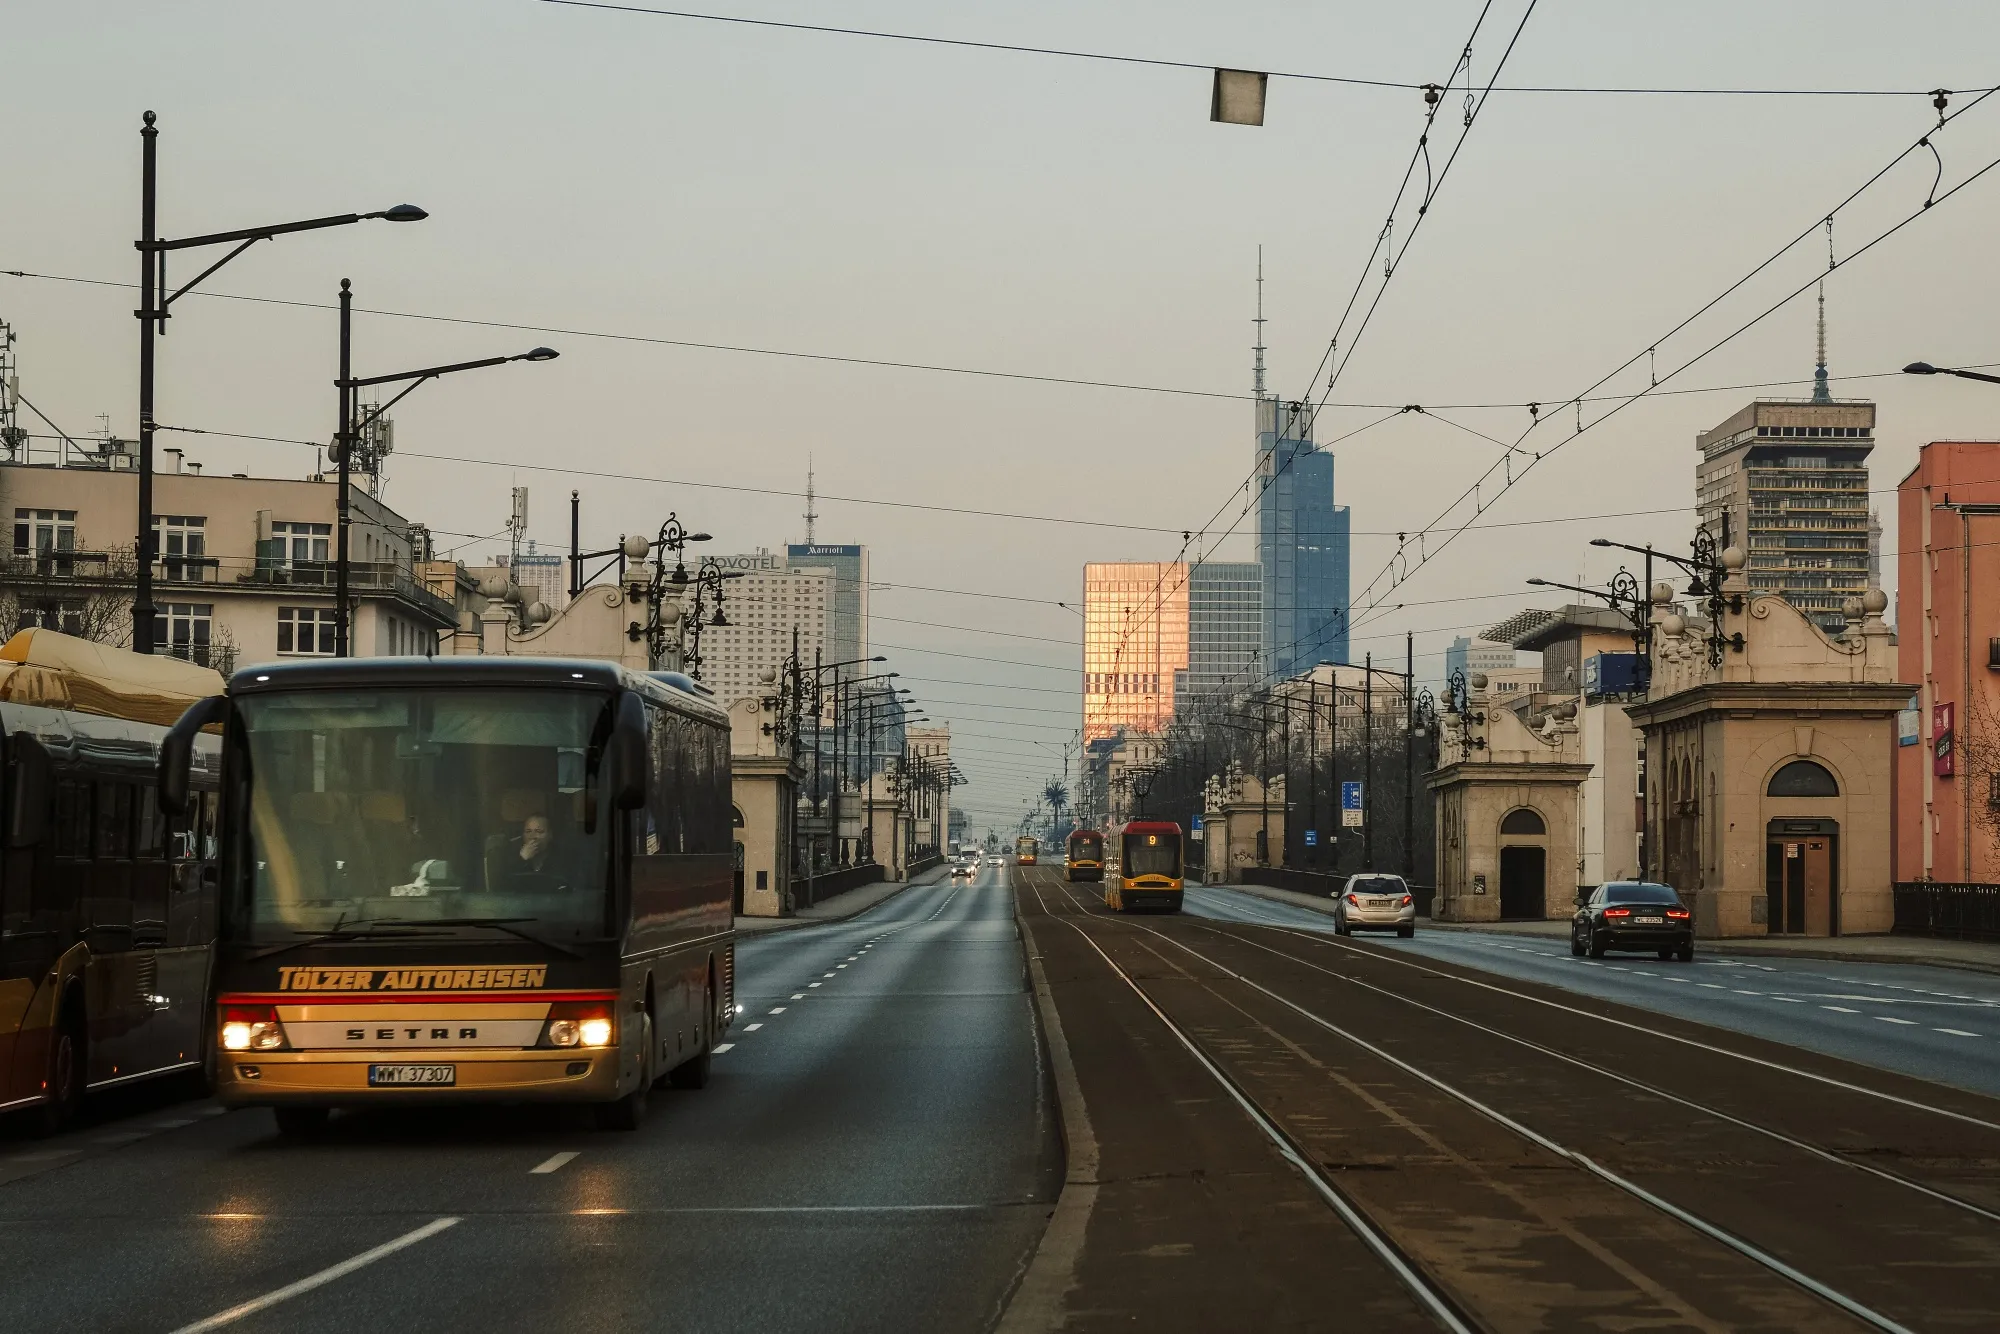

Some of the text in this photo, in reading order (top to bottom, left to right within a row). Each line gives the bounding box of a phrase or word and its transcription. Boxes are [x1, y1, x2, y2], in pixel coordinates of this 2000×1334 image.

[807, 546, 843, 555] Marriott
[701, 556, 781, 570] NOVOTEL
[1149, 835, 1156, 845] 9
[278, 966, 546, 990] TÖLZER AUTOREISEN
[346, 1028, 478, 1040] SETRA
[376, 1066, 453, 1082] WWY 37307
